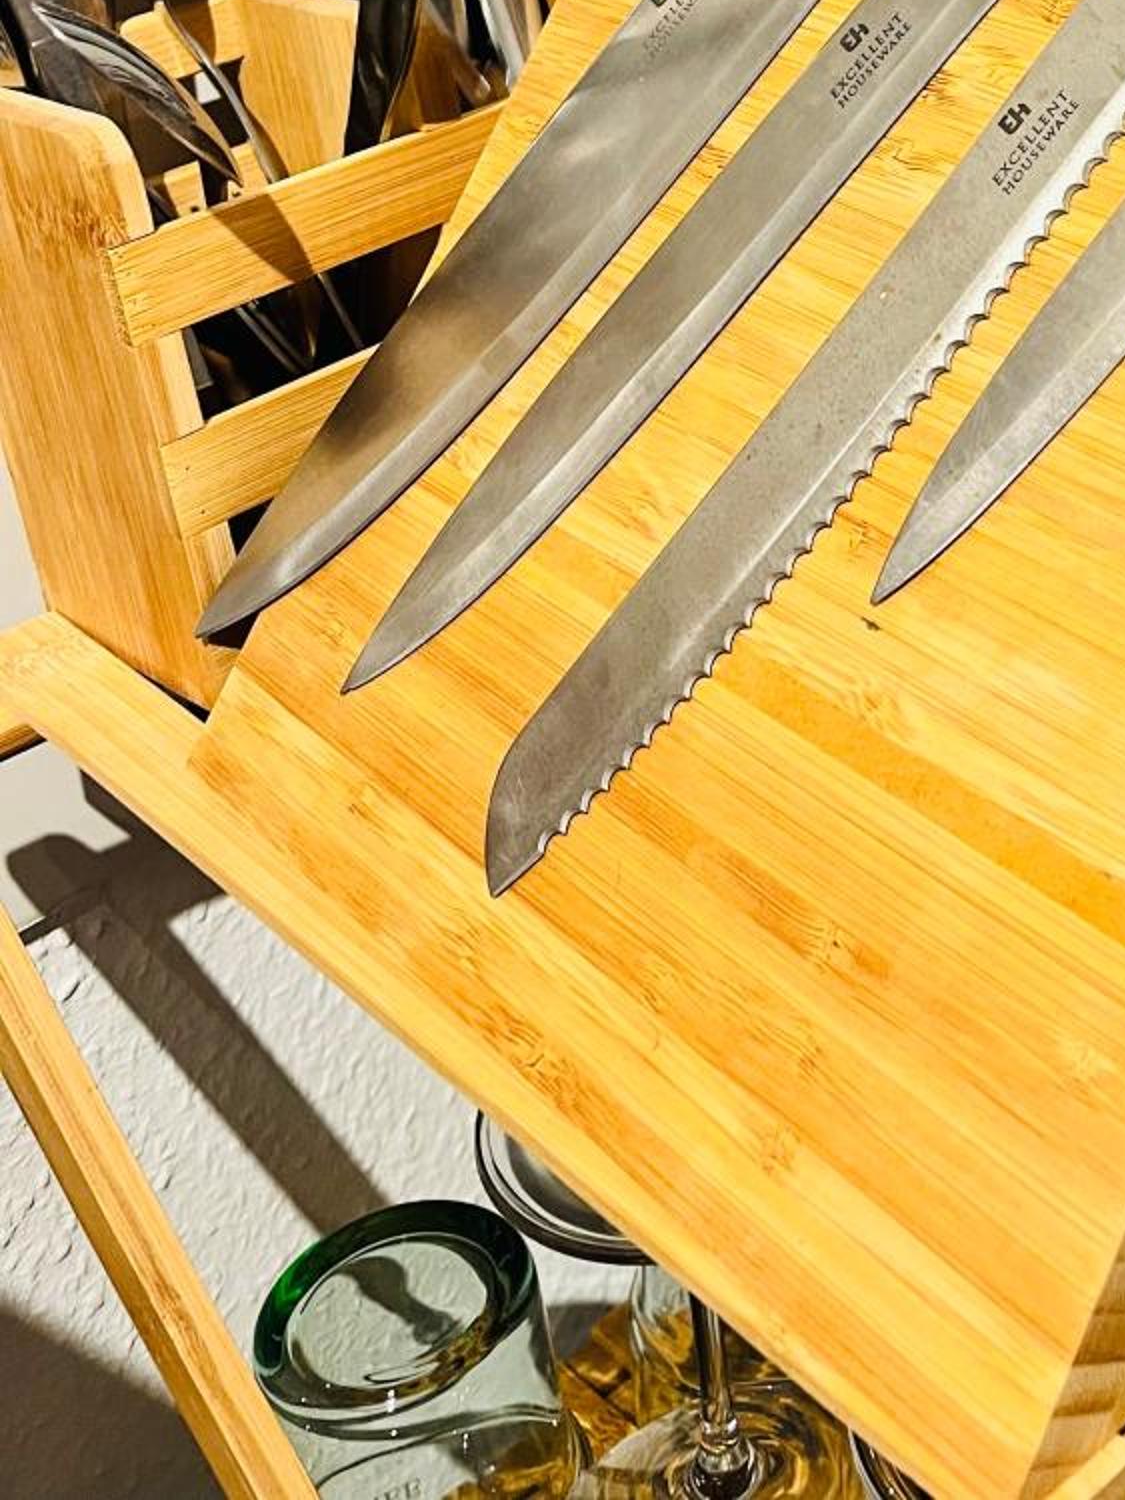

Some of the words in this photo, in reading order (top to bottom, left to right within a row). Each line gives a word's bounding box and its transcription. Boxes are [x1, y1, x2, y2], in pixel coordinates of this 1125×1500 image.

[829, 11, 902, 99] EXCELLENT
[837, 21, 911, 109] HOUSEWARE
[991, 89, 1068, 187] EXCELLENT
[1002, 99, 1080, 196] HOUSEWARE
